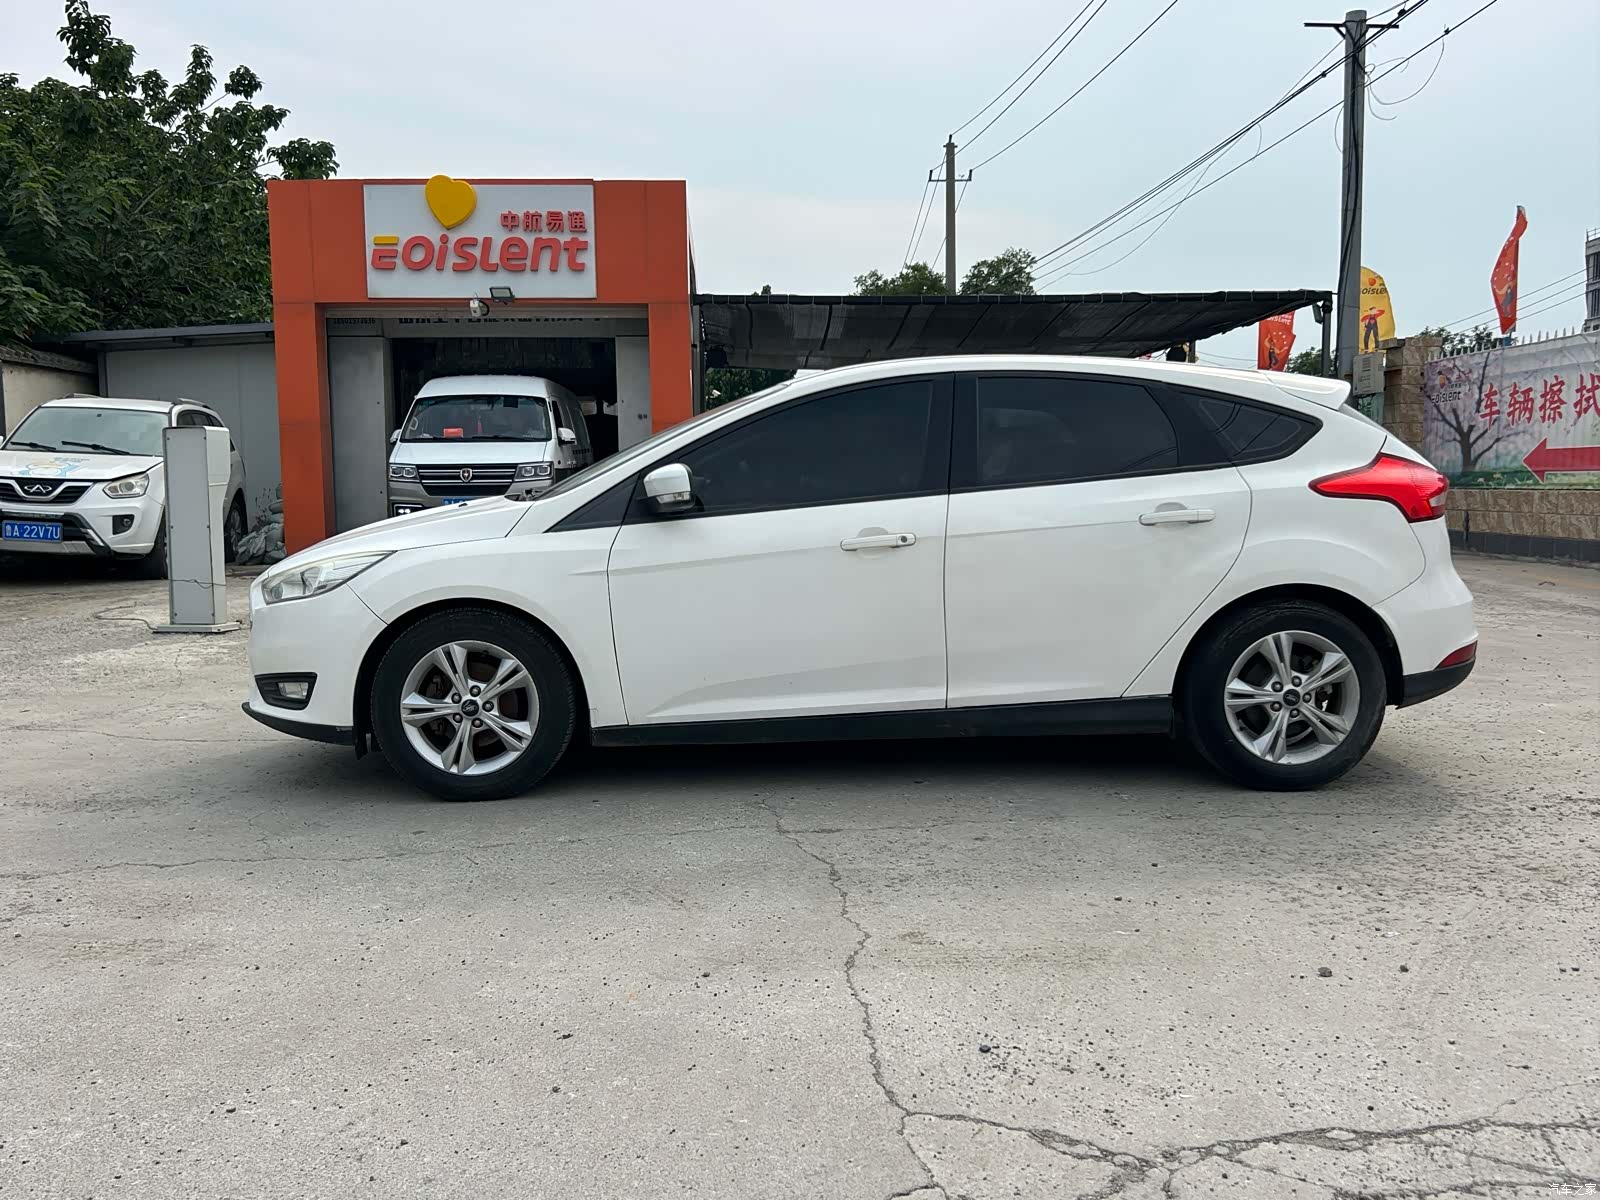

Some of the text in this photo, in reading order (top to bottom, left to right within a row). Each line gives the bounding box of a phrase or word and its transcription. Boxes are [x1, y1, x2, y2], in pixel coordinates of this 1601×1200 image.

[500, 210, 587, 232] 中航易通
[1480, 373, 1600, 431] 车辆擦拭
